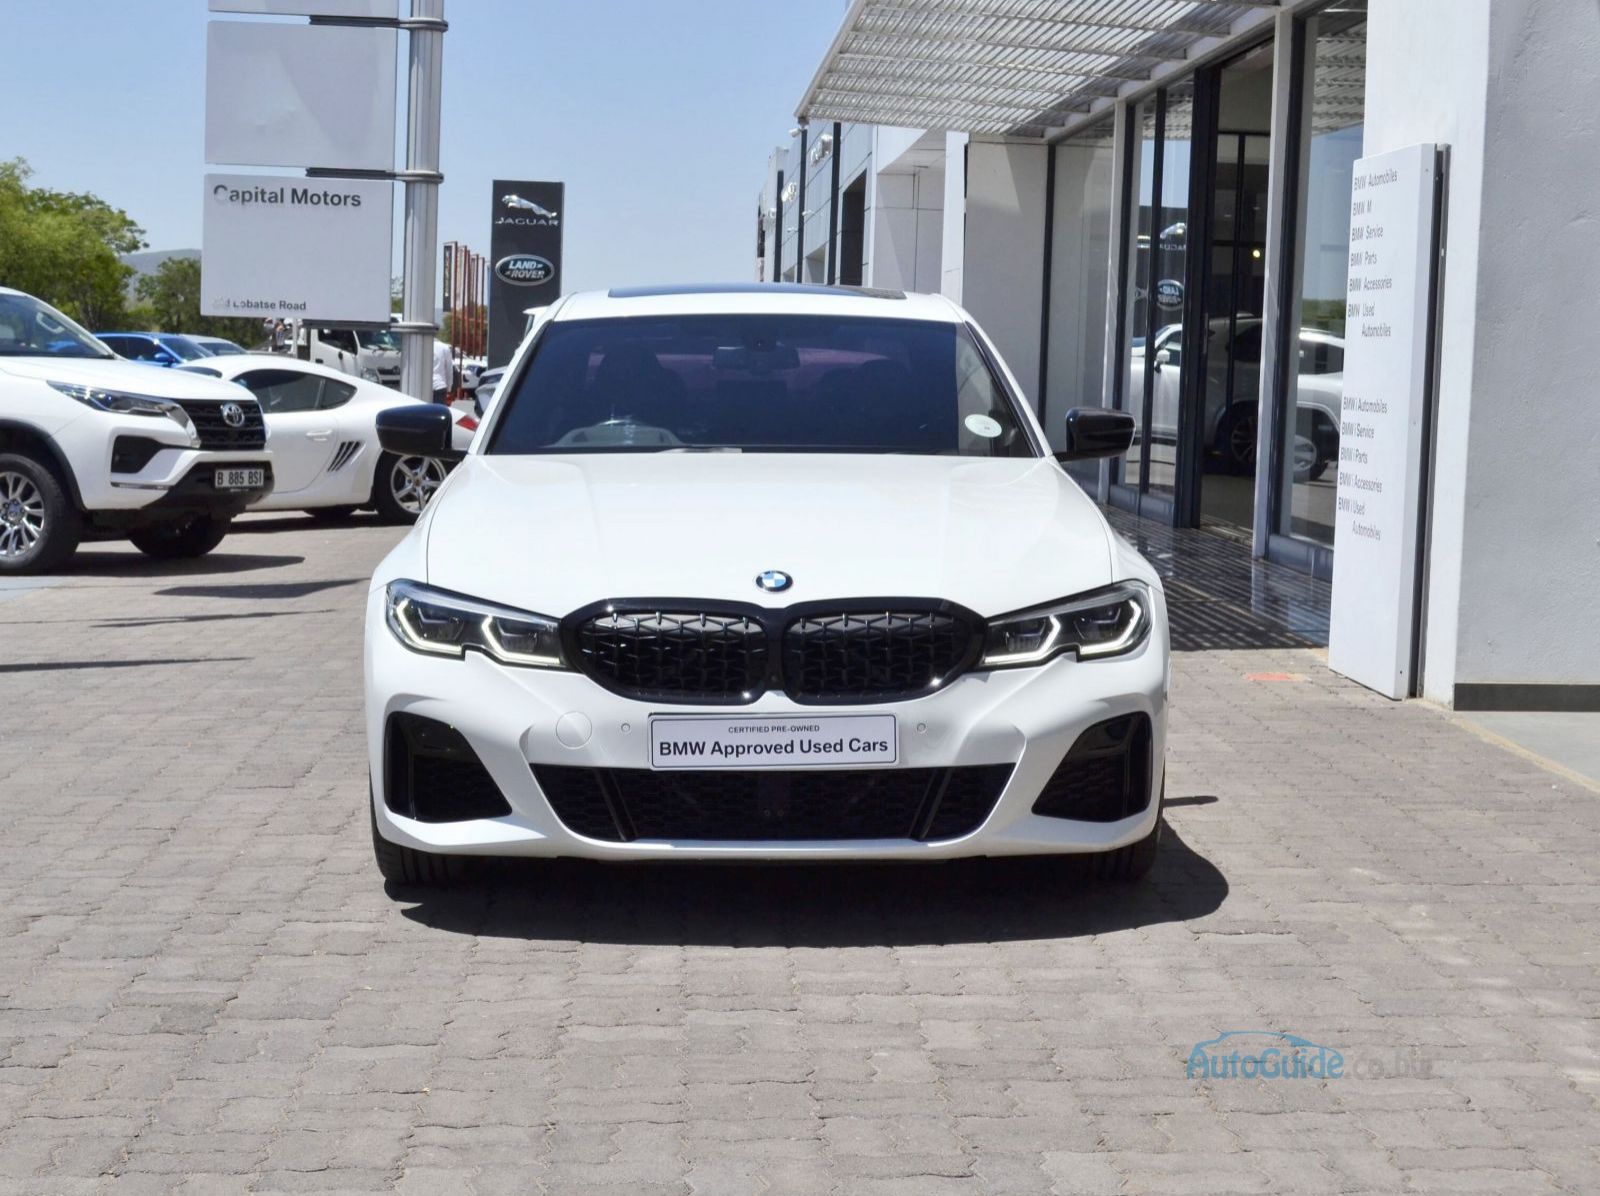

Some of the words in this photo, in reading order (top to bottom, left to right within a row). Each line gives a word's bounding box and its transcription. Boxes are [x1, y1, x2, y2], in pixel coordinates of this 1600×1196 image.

[291, 187, 362, 207] Motors
[495, 217, 559, 226] JAGUAR
[508, 260, 537, 269] LAND
[511, 269, 545, 279] ROVER
[279, 300, 307, 311] Road
[728, 726, 769, 734] CERTIFIED
[771, 724, 820, 733] PRE-OWNED
[659, 741, 705, 756] BMW
[710, 739, 795, 758] Approved
[799, 738, 844, 754] Used
[848, 737, 888, 752] Cars
